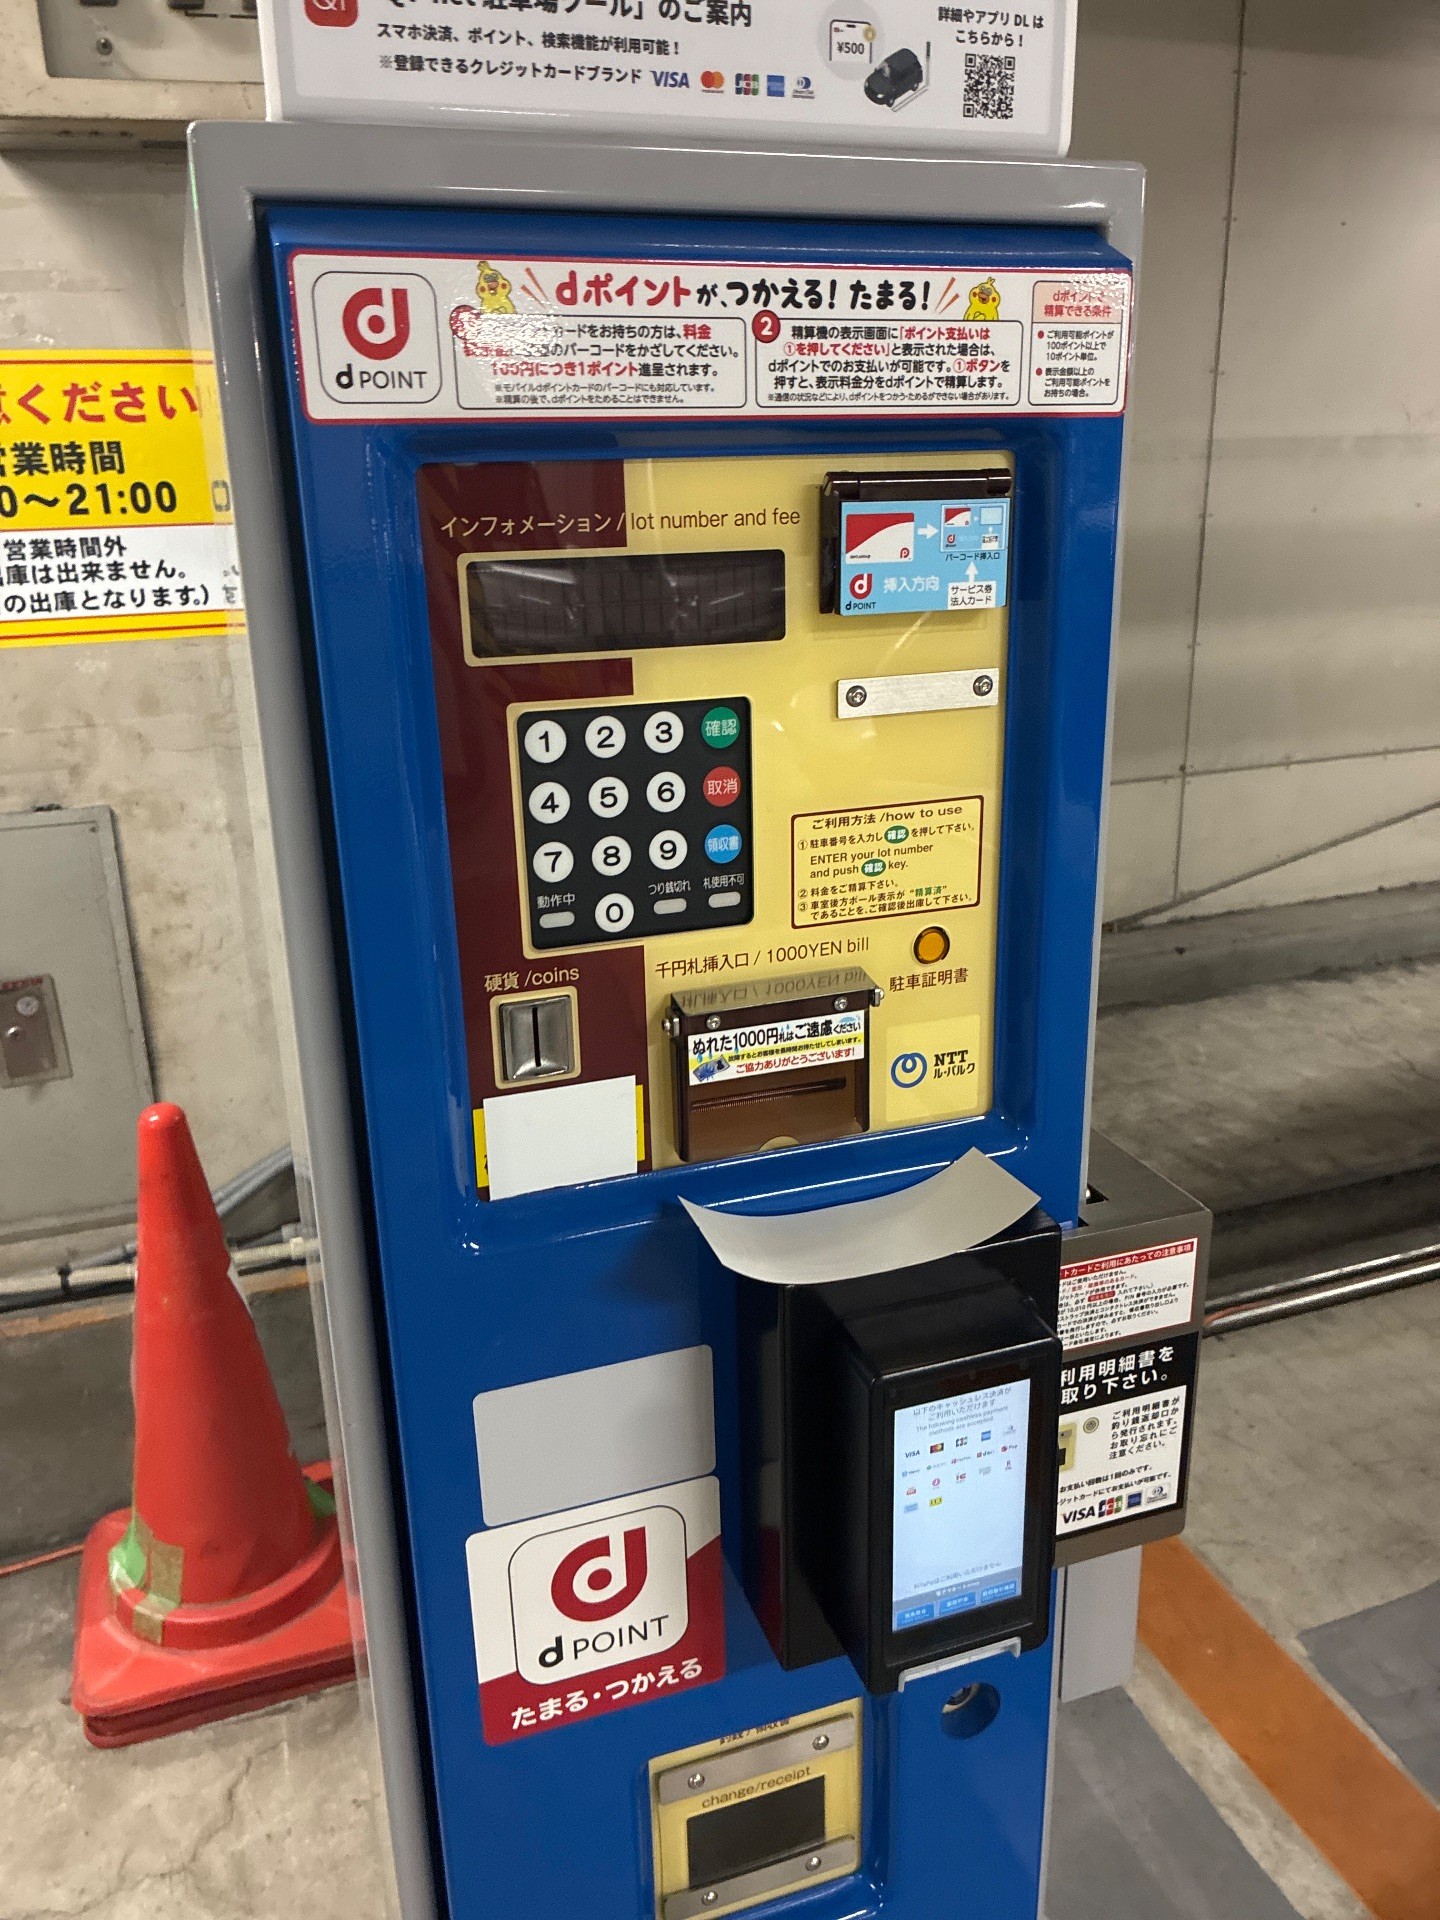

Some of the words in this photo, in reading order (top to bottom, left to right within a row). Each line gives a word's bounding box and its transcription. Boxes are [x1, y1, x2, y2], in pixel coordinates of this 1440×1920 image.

[938, 6, 1010, 26] 詳細やアプリ
[1014, 14, 1030, 27] DL
[1033, 16, 1044, 29] は
[837, 42, 865, 55] ¥500
[650, 70, 690, 89] VISA
[360, 370, 428, 390] POINT
[0, 381, 198, 425] ください
[0, 440, 126, 478] 業時間
[440, 513, 611, 538] インフォメーション
[660, 509, 729, 529] number
[734, 508, 767, 527] and
[772, 507, 801, 525] fee
[3, 534, 128, 562] 営業時間外
[0, 558, 187, 587] 庫は出来ません。
[883, 575, 940, 594] 挿入方向
[951, 584, 993, 595] サービス券
[951, 596, 992, 607] 法人カード
[853, 602, 877, 611] POINT
[539, 731, 550, 753] 1
[597, 725, 615, 748] 2
[655, 721, 673, 743] 3
[705, 718, 737, 737] 確認
[541, 791, 560, 813] 4
[600, 787, 618, 808] 5
[658, 782, 675, 802] 6
[707, 778, 739, 796] 取消
[812, 814, 876, 830] ご利用方法
[920, 808, 933, 818] to
[938, 805, 963, 816] use
[887, 828, 907, 840] 確認
[544, 851, 563, 872] 7
[603, 845, 621, 867] 8
[659, 839, 677, 860] 9
[707, 836, 740, 852] 領収書
[810, 853, 848, 866] ENTER
[851, 850, 875, 864] your
[877, 848, 891, 859] lot
[894, 844, 934, 857] number
[810, 867, 830, 879] and
[833, 864, 859, 879] push
[864, 862, 884, 874] 確認
[888, 859, 909, 871] key.
[537, 893, 576, 909] 動作中
[648, 878, 691, 895] つり銭切れ
[703, 873, 745, 890] 札使用不可
[655, 952, 749, 979] 千円札挿入口
[767, 940, 842, 963] 1000YEN
[847, 936, 870, 954] bill
[484, 971, 519, 992] 硬貨
[889, 967, 969, 992] 駐車証明書
[934, 1050, 968, 1067] NTT
[1057, 1471, 1171, 1506] ジットカードにてお支払いが可能です。
[1063, 1506, 1096, 1524] VISA
[573, 1614, 670, 1661] POINT
[511, 1656, 703, 1731] たまる・つかえる
